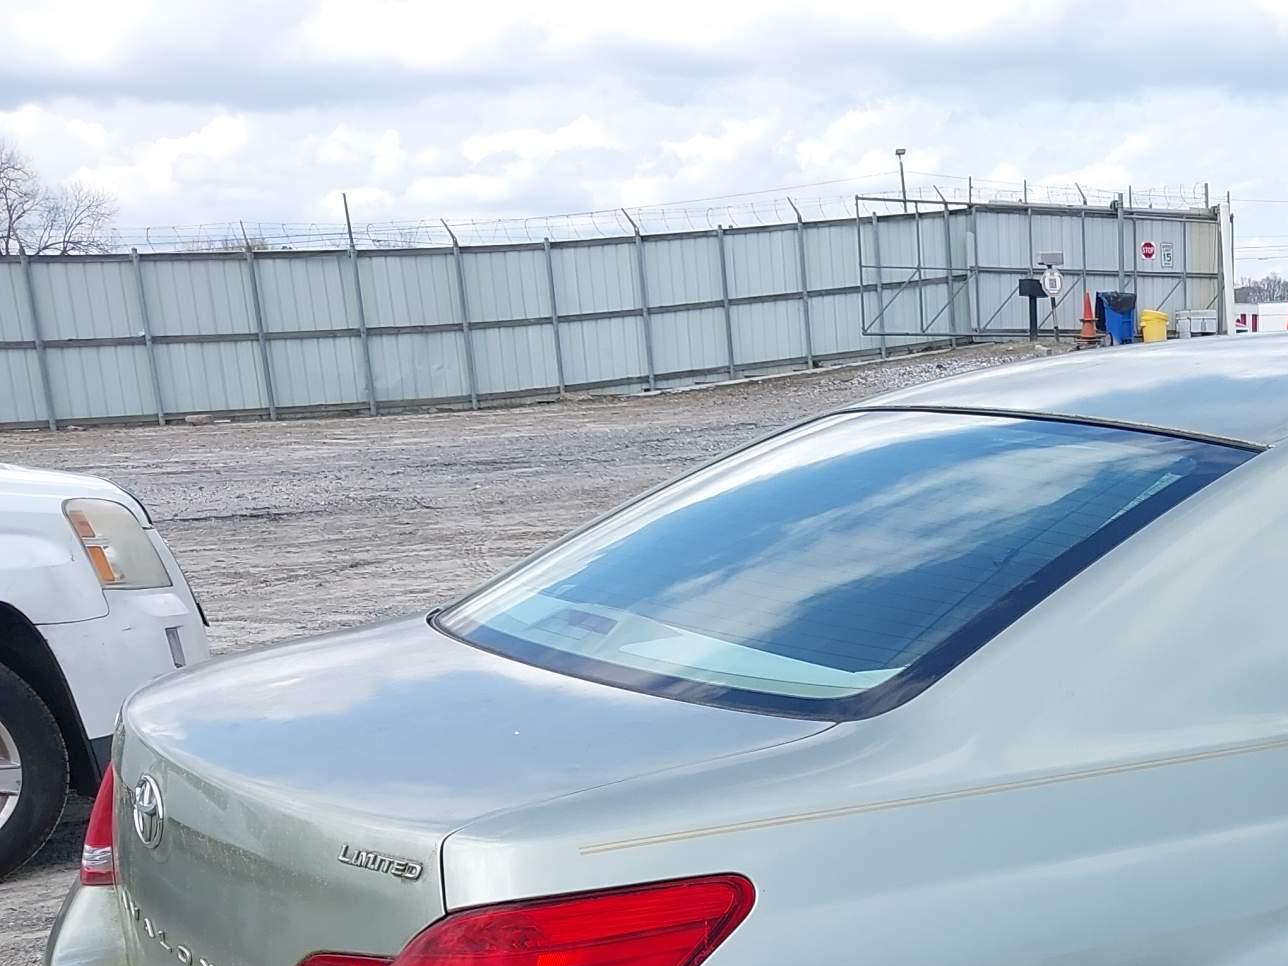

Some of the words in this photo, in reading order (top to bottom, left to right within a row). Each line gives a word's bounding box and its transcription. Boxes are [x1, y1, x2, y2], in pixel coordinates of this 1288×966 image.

[1142, 246, 1154, 254] STOP
[1163, 252, 1172, 262] 15
[337, 843, 424, 881] LIMITED
